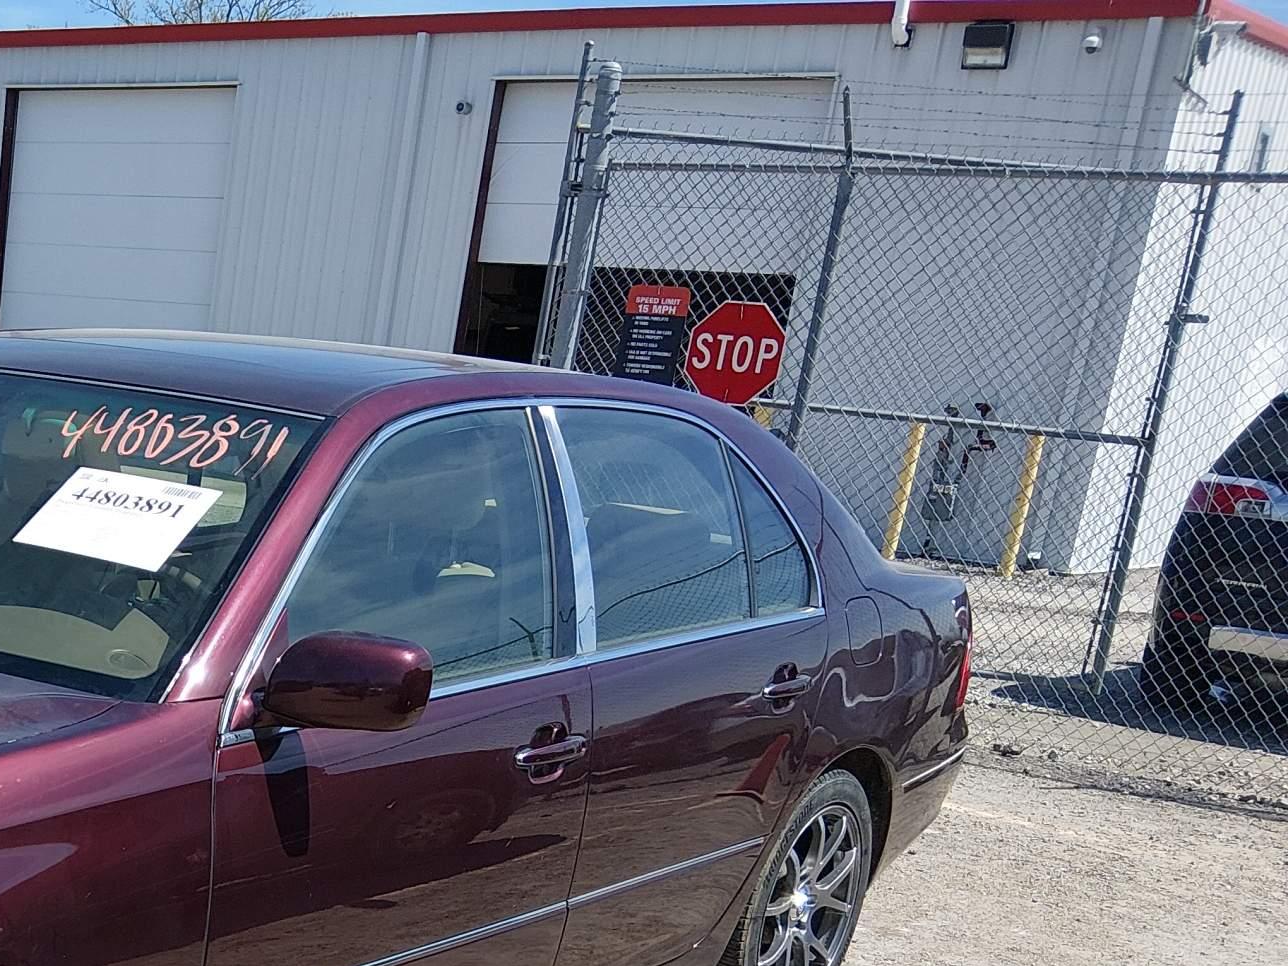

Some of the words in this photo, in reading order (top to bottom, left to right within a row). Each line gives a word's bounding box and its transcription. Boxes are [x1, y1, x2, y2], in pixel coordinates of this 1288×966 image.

[636, 296, 659, 305] SPEED
[660, 297, 682, 306] LIMIT
[638, 304, 650, 314] 15
[651, 304, 677, 315] MPH
[691, 332, 779, 374] STOP
[62, 405, 290, 480] 44803891
[71, 487, 185, 519] 44803891
